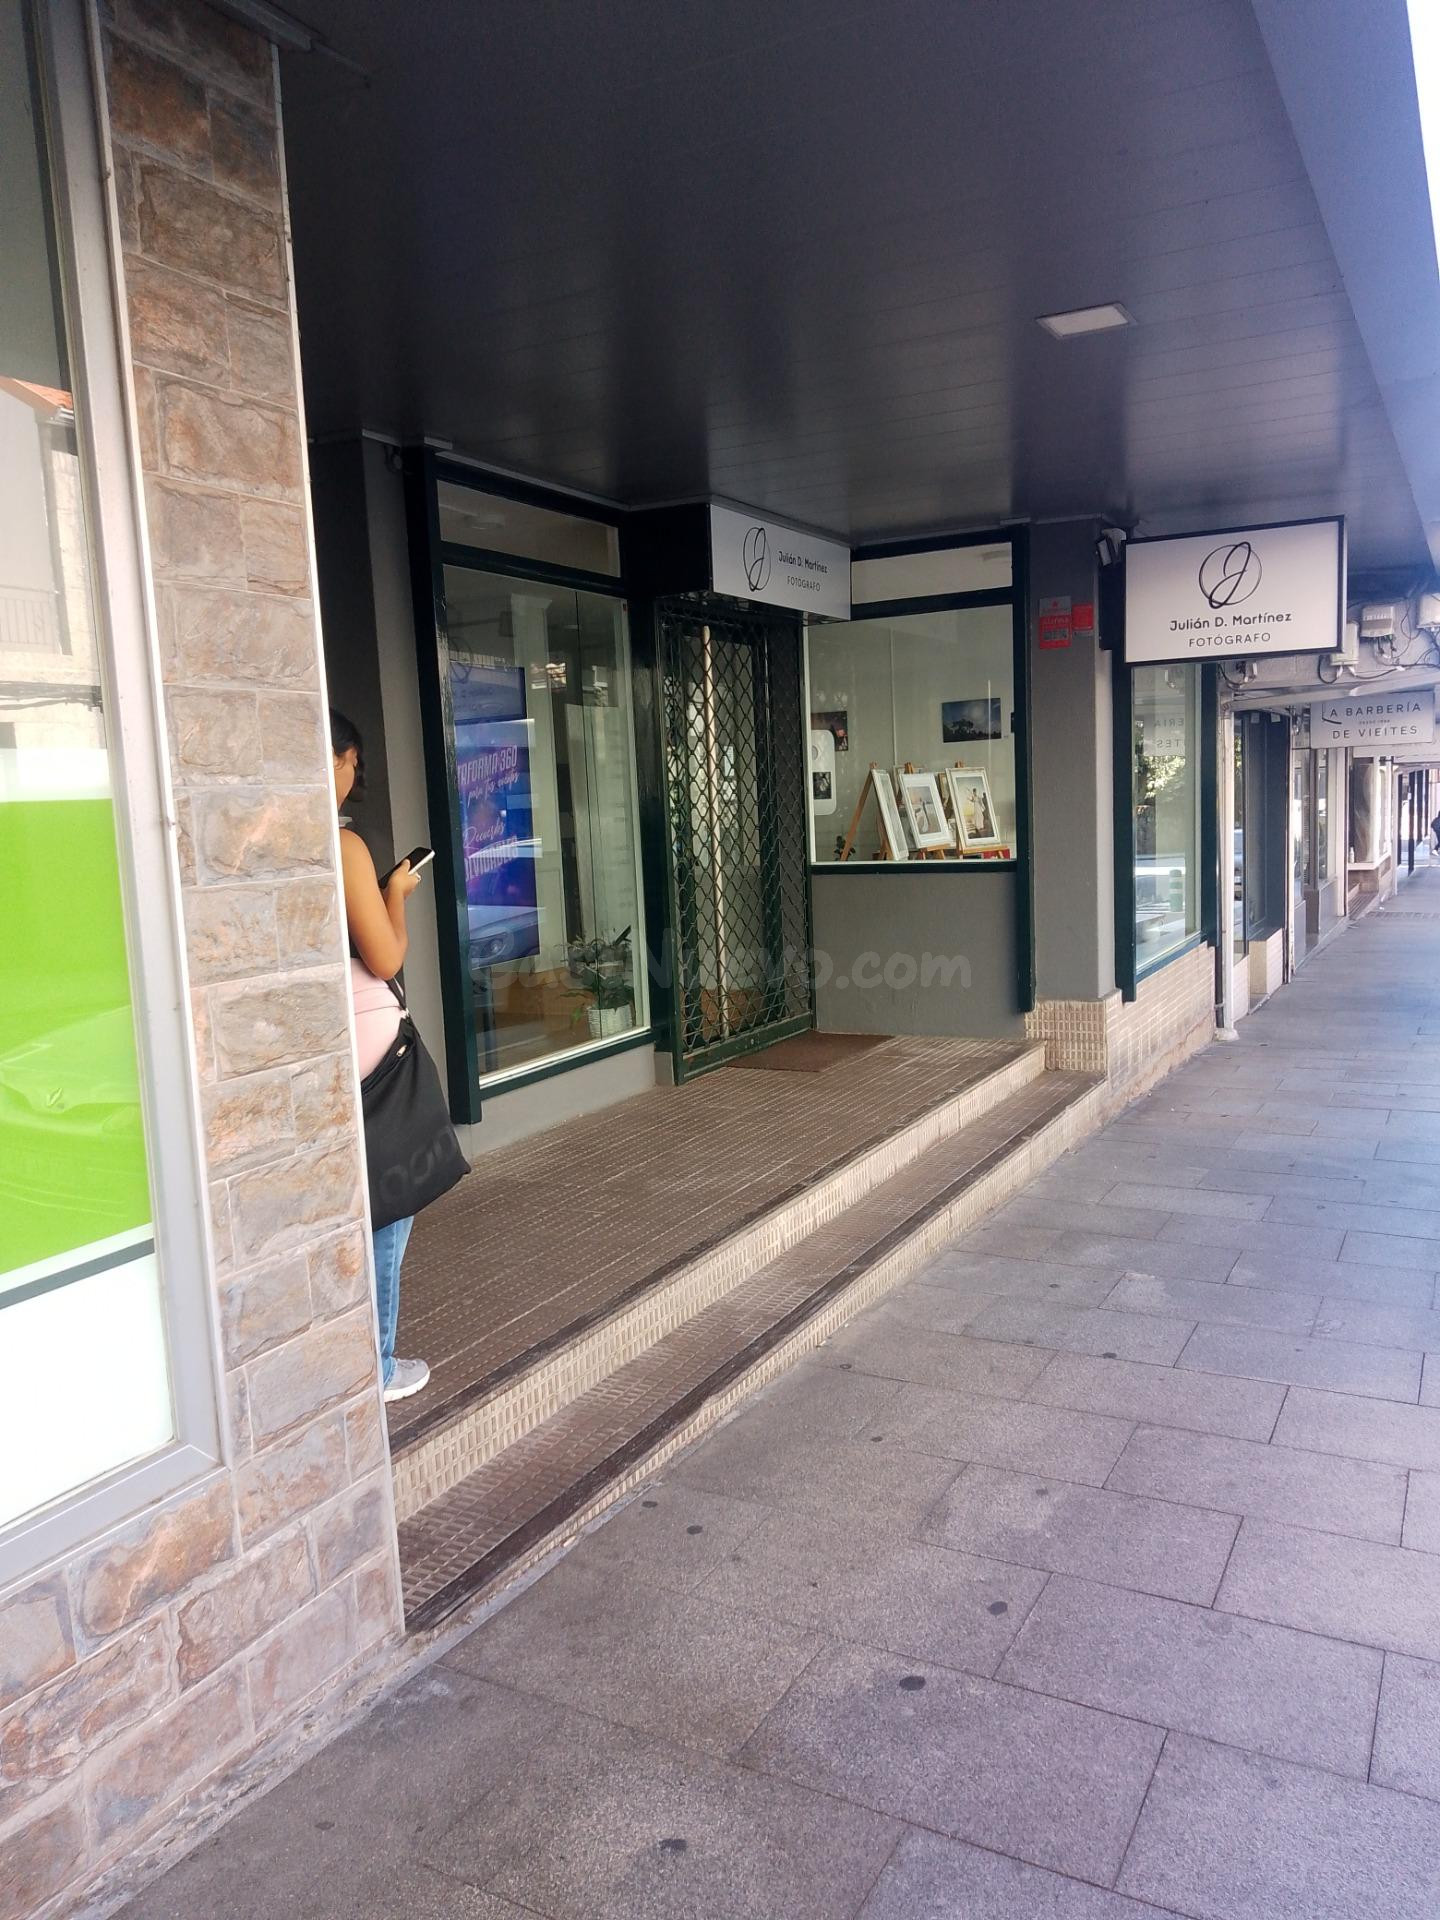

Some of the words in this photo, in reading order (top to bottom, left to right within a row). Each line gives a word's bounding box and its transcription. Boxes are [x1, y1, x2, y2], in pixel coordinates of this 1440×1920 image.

[778, 551, 797, 565] Julián
[1170, 617, 1210, 632] Julián
[1215, 616, 1228, 628] D.
[1233, 612, 1292, 627] Martínez
[1189, 632, 1271, 648] FOTÓGRAFO
[1346, 702, 1421, 717] BARBERÍA
[1333, 729, 1351, 739] DE
[1358, 726, 1417, 738] VIEITES
[499, 744, 518, 771] 360
